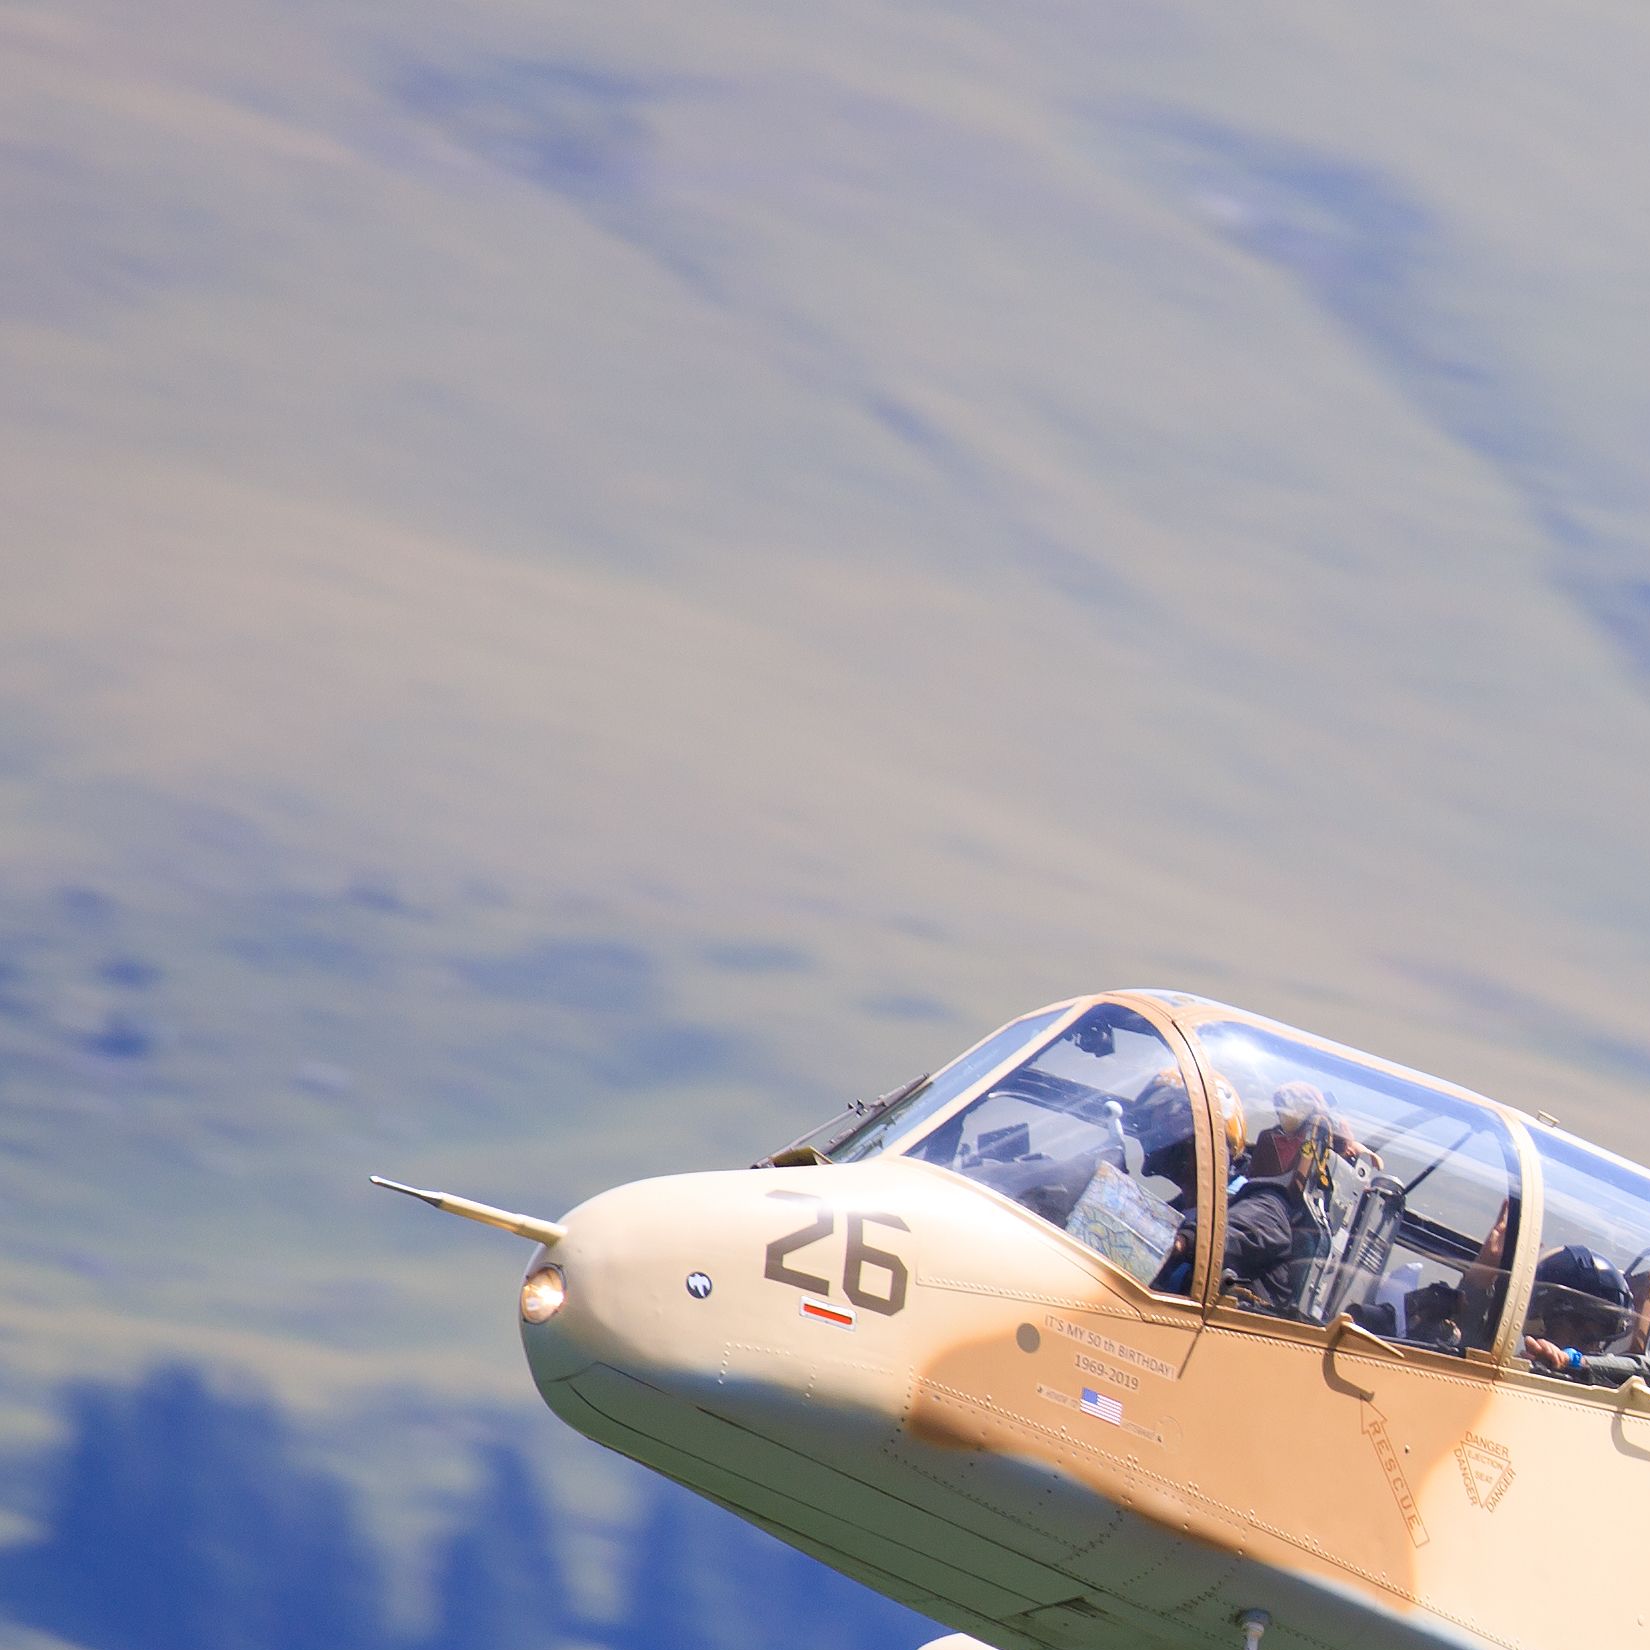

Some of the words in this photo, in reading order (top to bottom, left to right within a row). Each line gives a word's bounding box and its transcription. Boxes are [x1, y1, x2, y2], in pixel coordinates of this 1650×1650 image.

[763, 1189, 911, 1317] 26
[1044, 1314, 1064, 1332] IT'S
[1067, 1324, 1084, 1341] MY
[1087, 1333, 1101, 1348] 50
[1103, 1340, 1116, 1353] th
[1074, 1354, 1140, 1391] 1969-2019
[1465, 1431, 1509, 1458] DANGER
[1369, 1420, 1421, 1531] RESCUE
[1454, 1448, 1478, 1506] DANGER
[1486, 1468, 1517, 1513] DANGER
